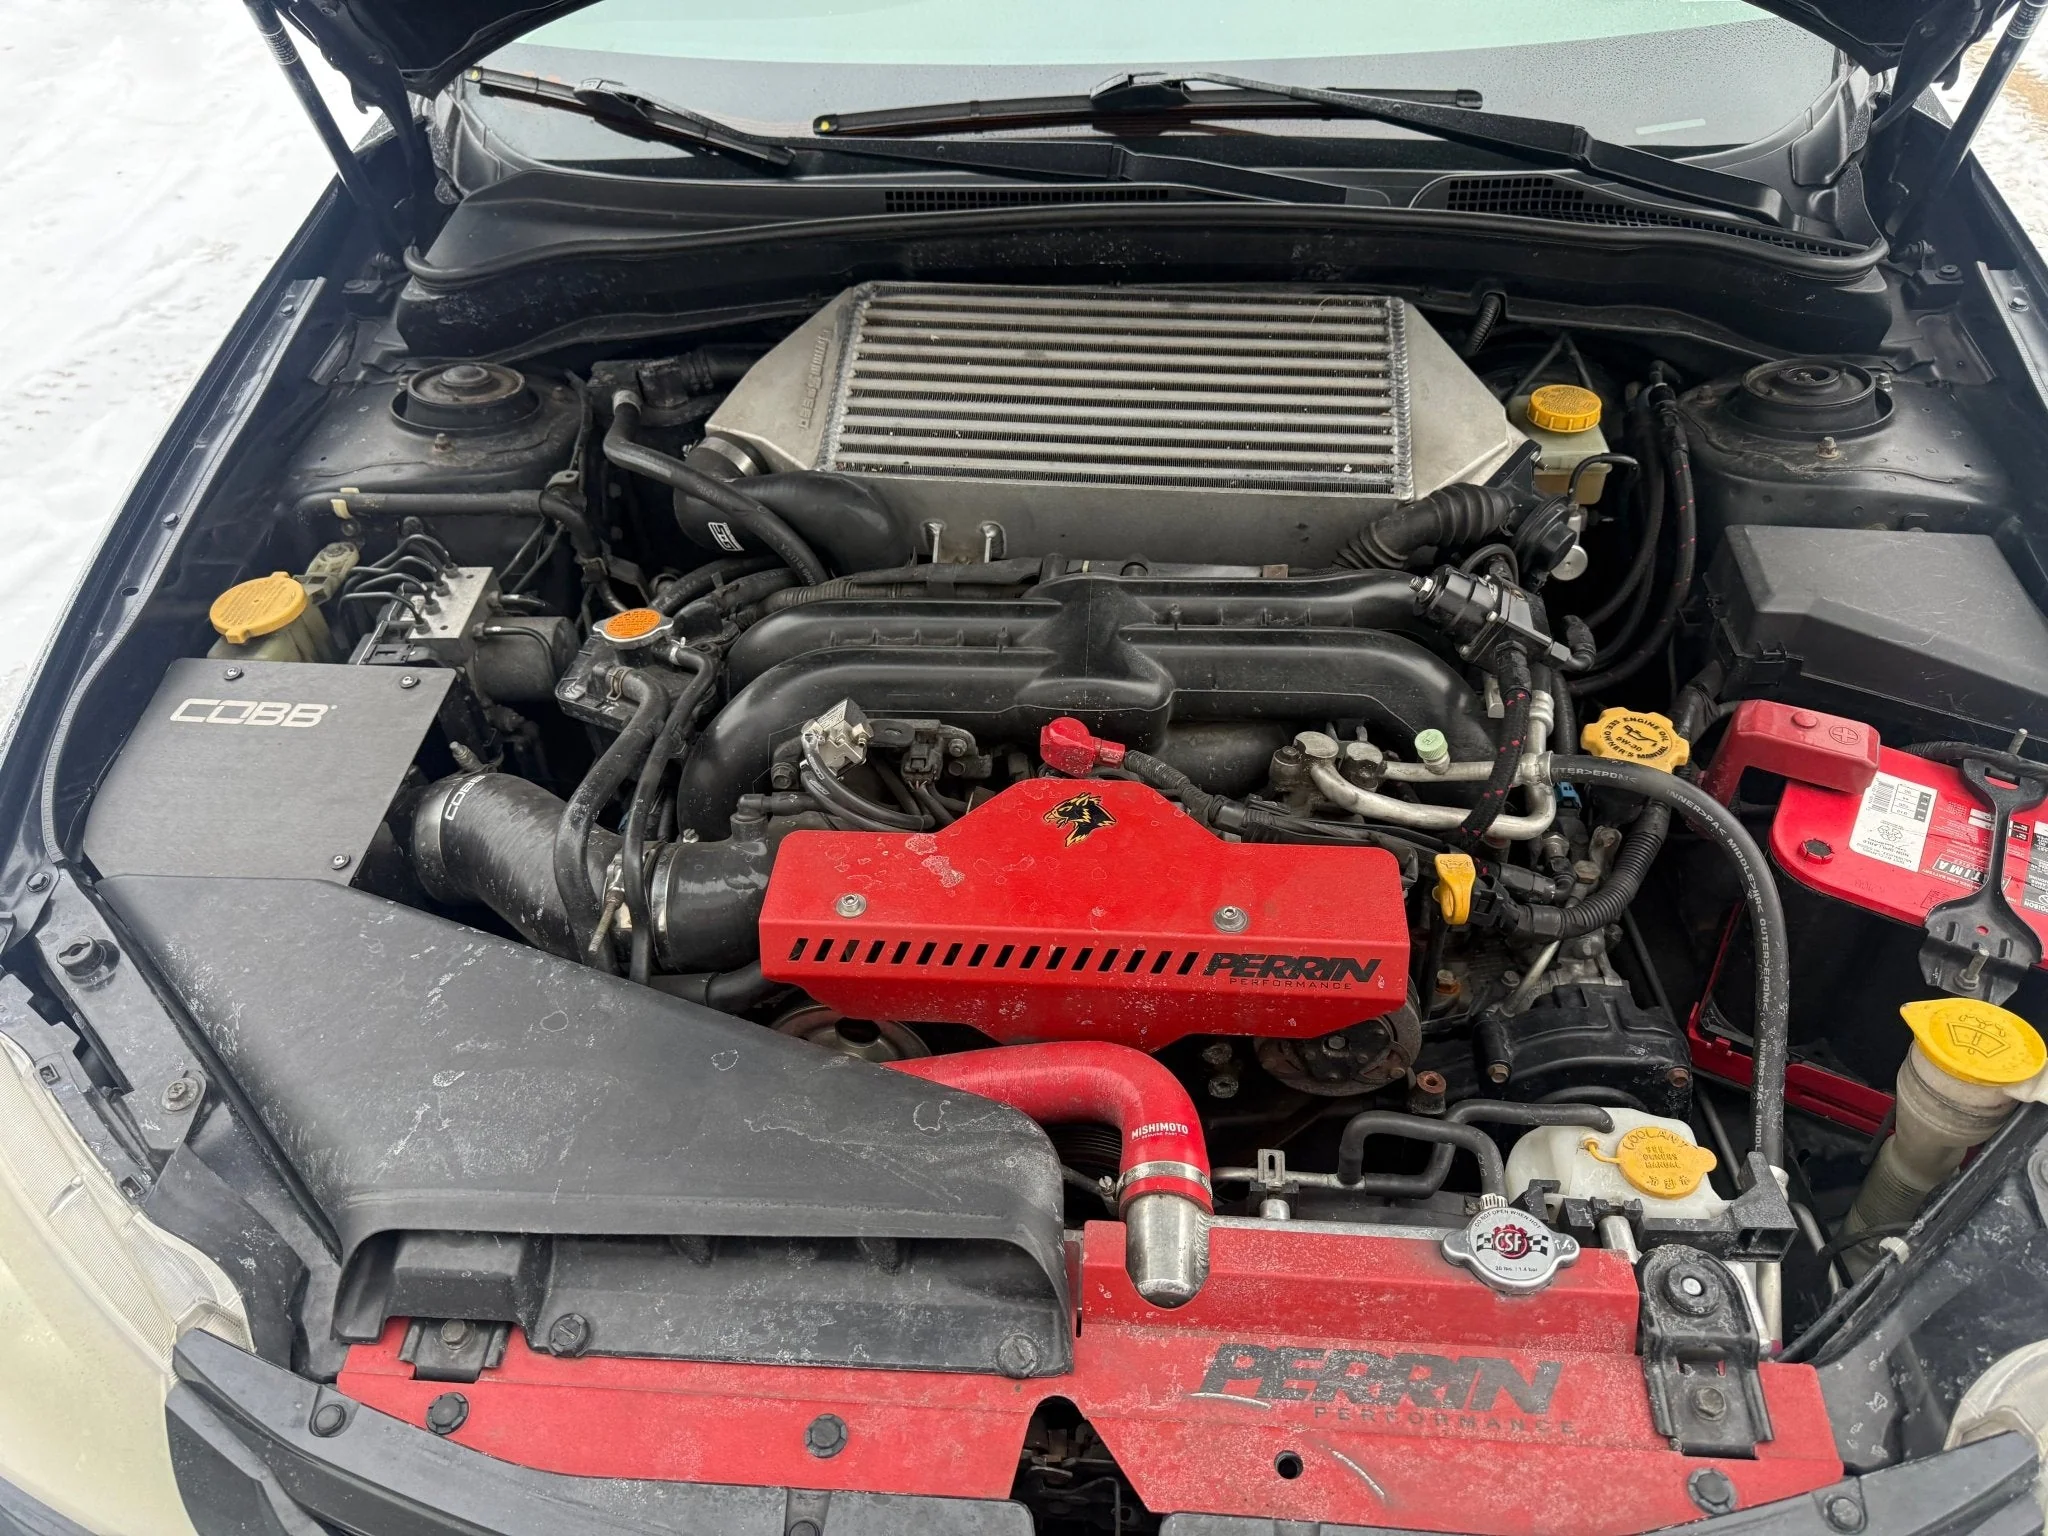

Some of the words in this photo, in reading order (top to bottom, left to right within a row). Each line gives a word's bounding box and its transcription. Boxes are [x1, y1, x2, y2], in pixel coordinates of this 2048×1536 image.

[170, 698, 328, 728] COBB
[1604, 719, 1621, 731] SEE
[1622, 717, 1660, 730] ENGINE
[1659, 729, 1669, 742] OIL
[1604, 730, 1634, 758] OWNER'S
[1615, 736, 1643, 752] 5W-30
[1636, 745, 1669, 759] MANUAL
[1551, 767, 1637, 783] UTER>EPDM<
[445, 775, 486, 820] COBB
[1938, 860, 1981, 882] TIMA
[1203, 953, 1382, 983] PERRIN
[1230, 978, 1352, 990] PERFORMANCE
[1131, 1122, 1188, 1139] MISHIMOTO
[1623, 1128, 1688, 1150] COOLANT
[1481, 1212, 1491, 1221] NOT
[1510, 1210, 1528, 1220] WHEN
[1529, 1218, 1541, 1229] HOT
[1494, 1232, 1522, 1252] CSF
[1200, 1343, 1563, 1415] PERRIN
[1314, 1406, 1578, 1435] PERFORMANCE
